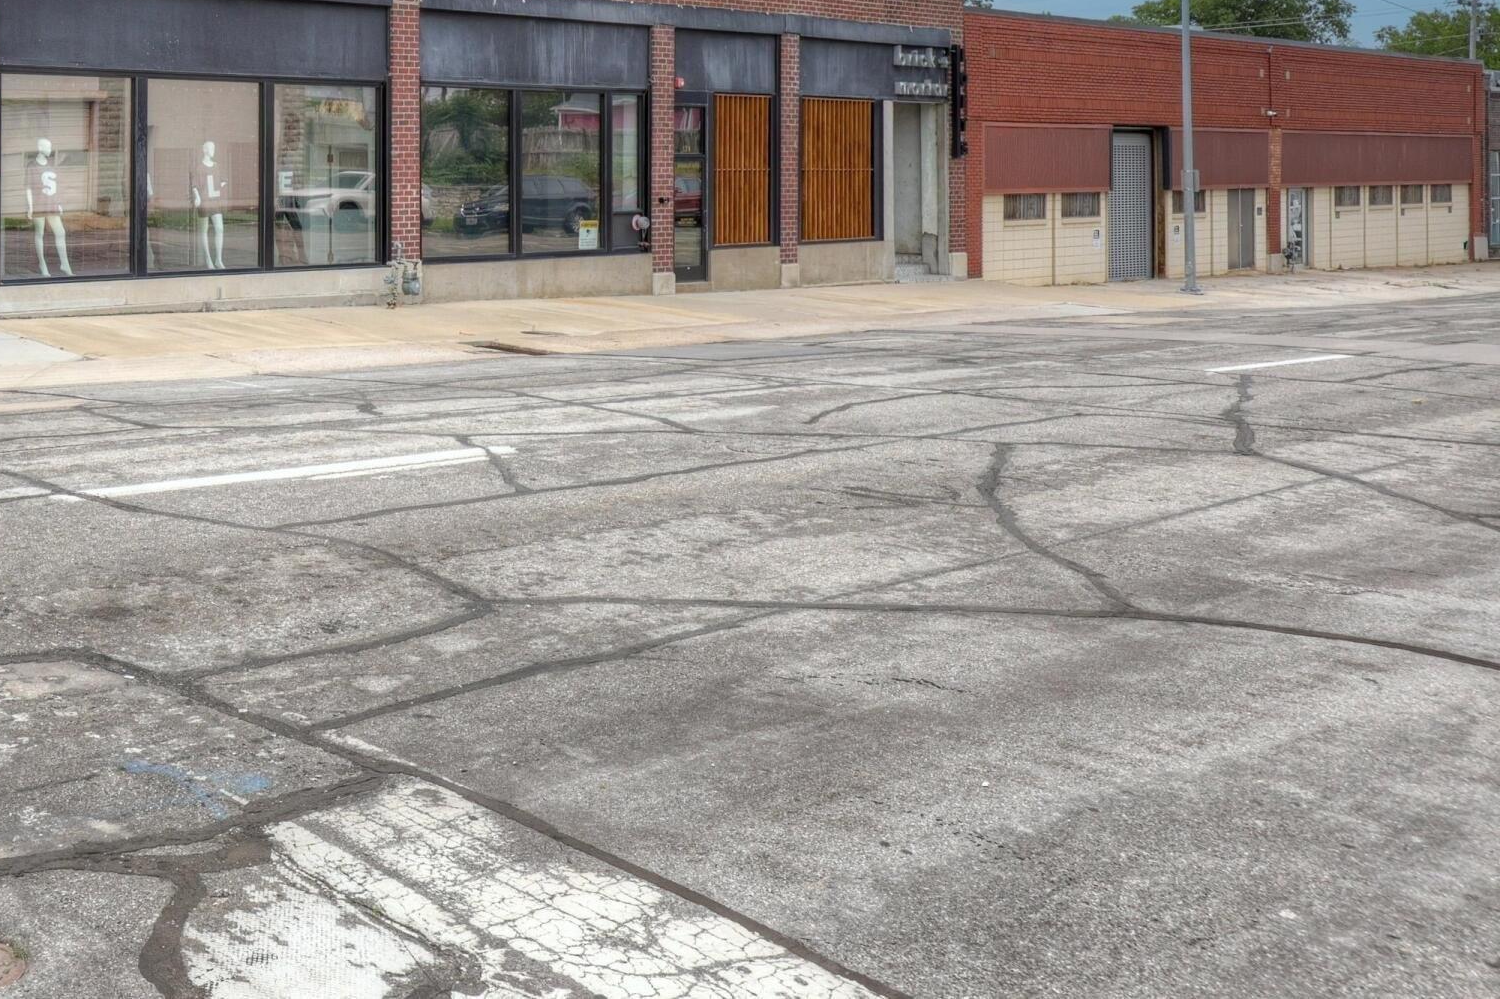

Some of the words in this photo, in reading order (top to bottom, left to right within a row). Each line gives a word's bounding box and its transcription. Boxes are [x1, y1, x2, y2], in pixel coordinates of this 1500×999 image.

[40, 171, 58, 196] S
[206, 174, 221, 198] L
[278, 170, 294, 193] E
